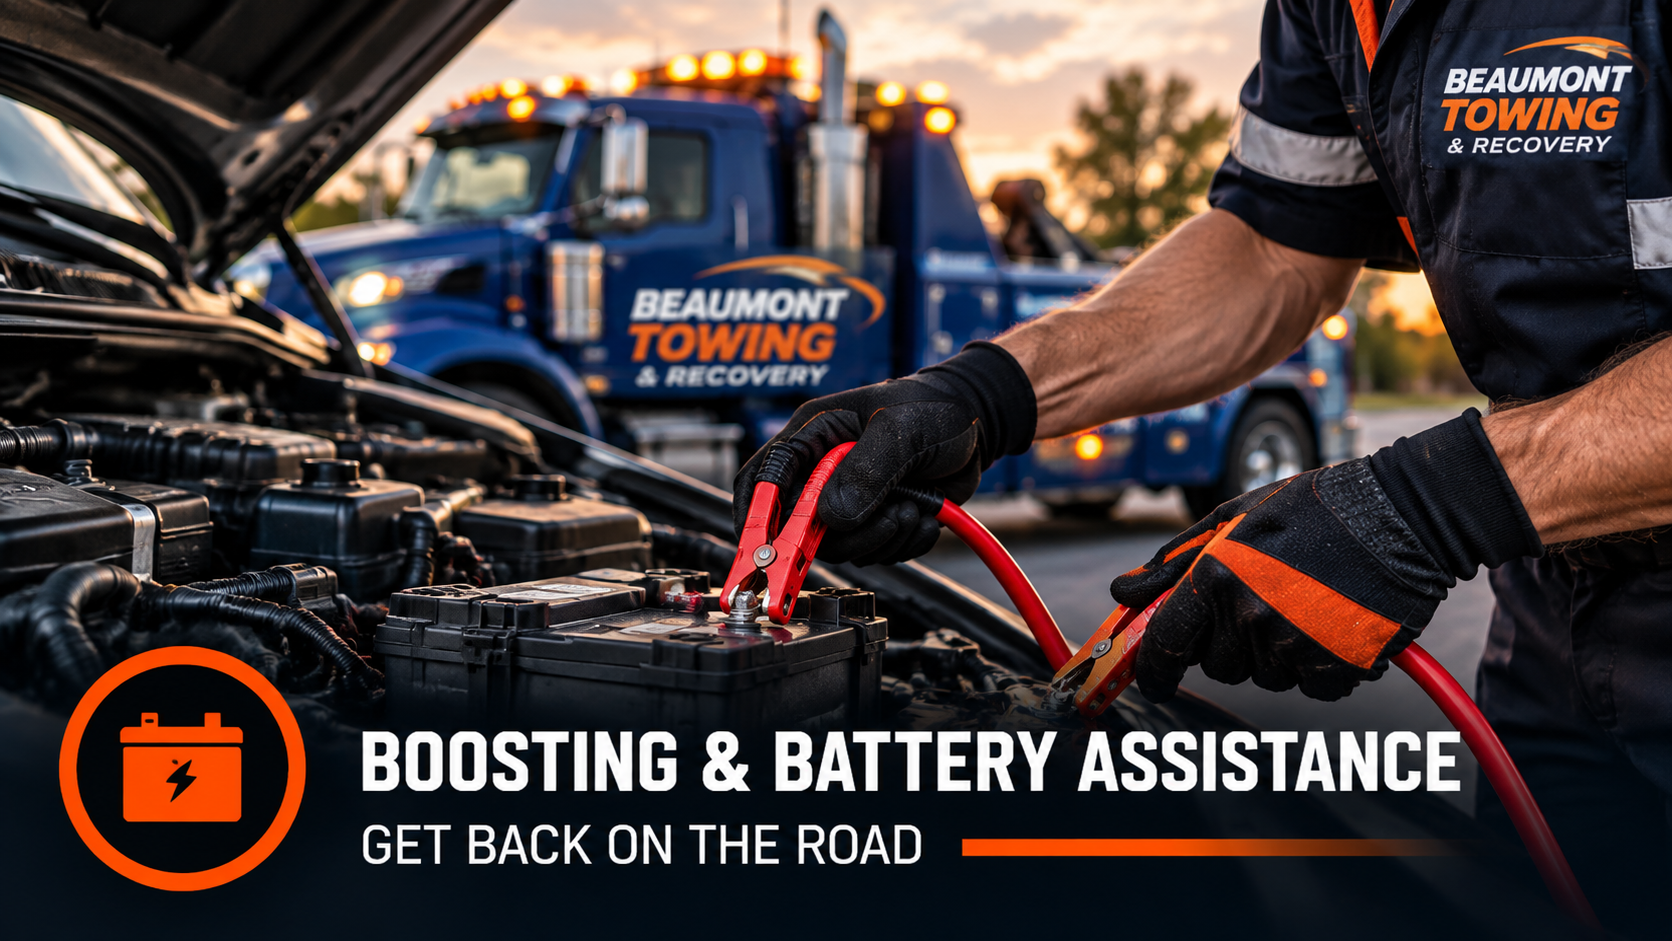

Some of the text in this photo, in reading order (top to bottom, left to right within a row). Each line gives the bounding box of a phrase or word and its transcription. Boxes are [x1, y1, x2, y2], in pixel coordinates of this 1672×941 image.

[1443, 65, 1634, 94] BEAUMONT
[1441, 97, 1620, 132] TOWING
[1447, 135, 1613, 154] & RECOVERY
[630, 288, 850, 321] BEAUMONT
[628, 323, 837, 362] TOWING
[635, 364, 829, 387] & RECOVERY
